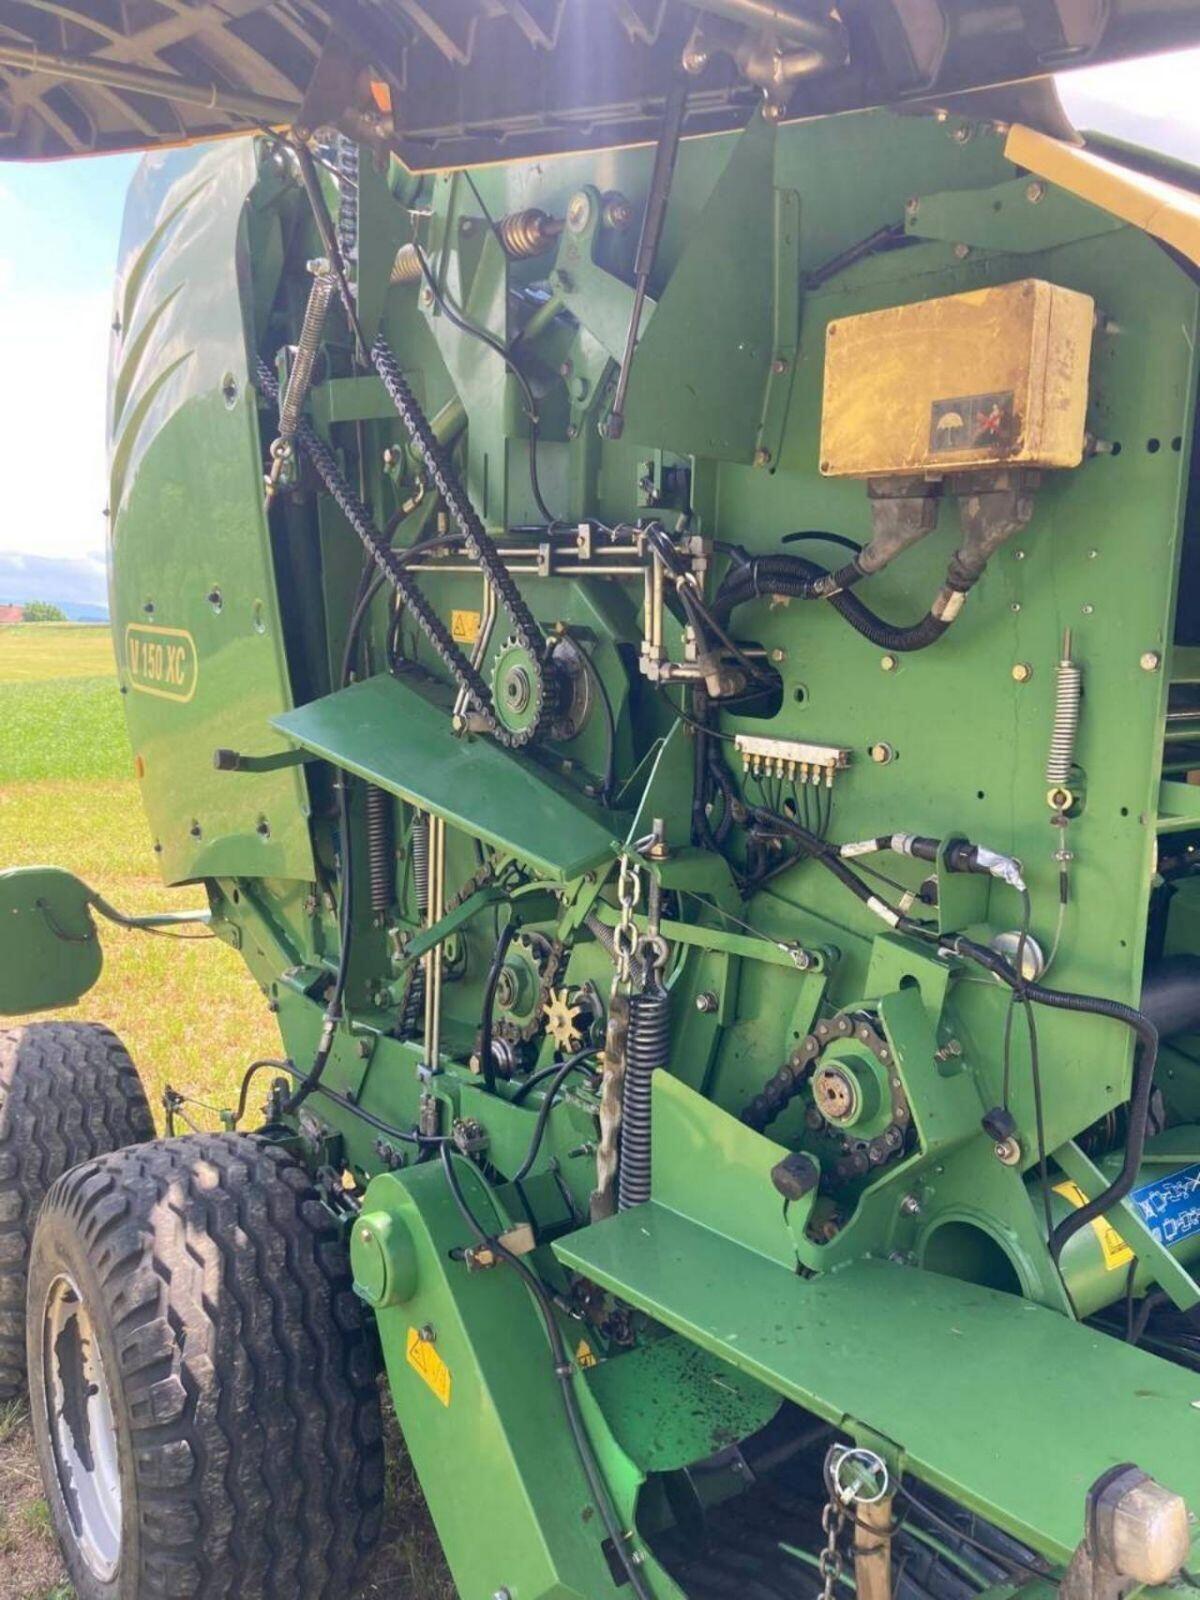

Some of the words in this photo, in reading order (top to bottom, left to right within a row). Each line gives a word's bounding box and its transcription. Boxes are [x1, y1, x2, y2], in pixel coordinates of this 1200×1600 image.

[129, 638, 139, 675] V
[142, 641, 163, 680] 150
[165, 645, 186, 685] XC
